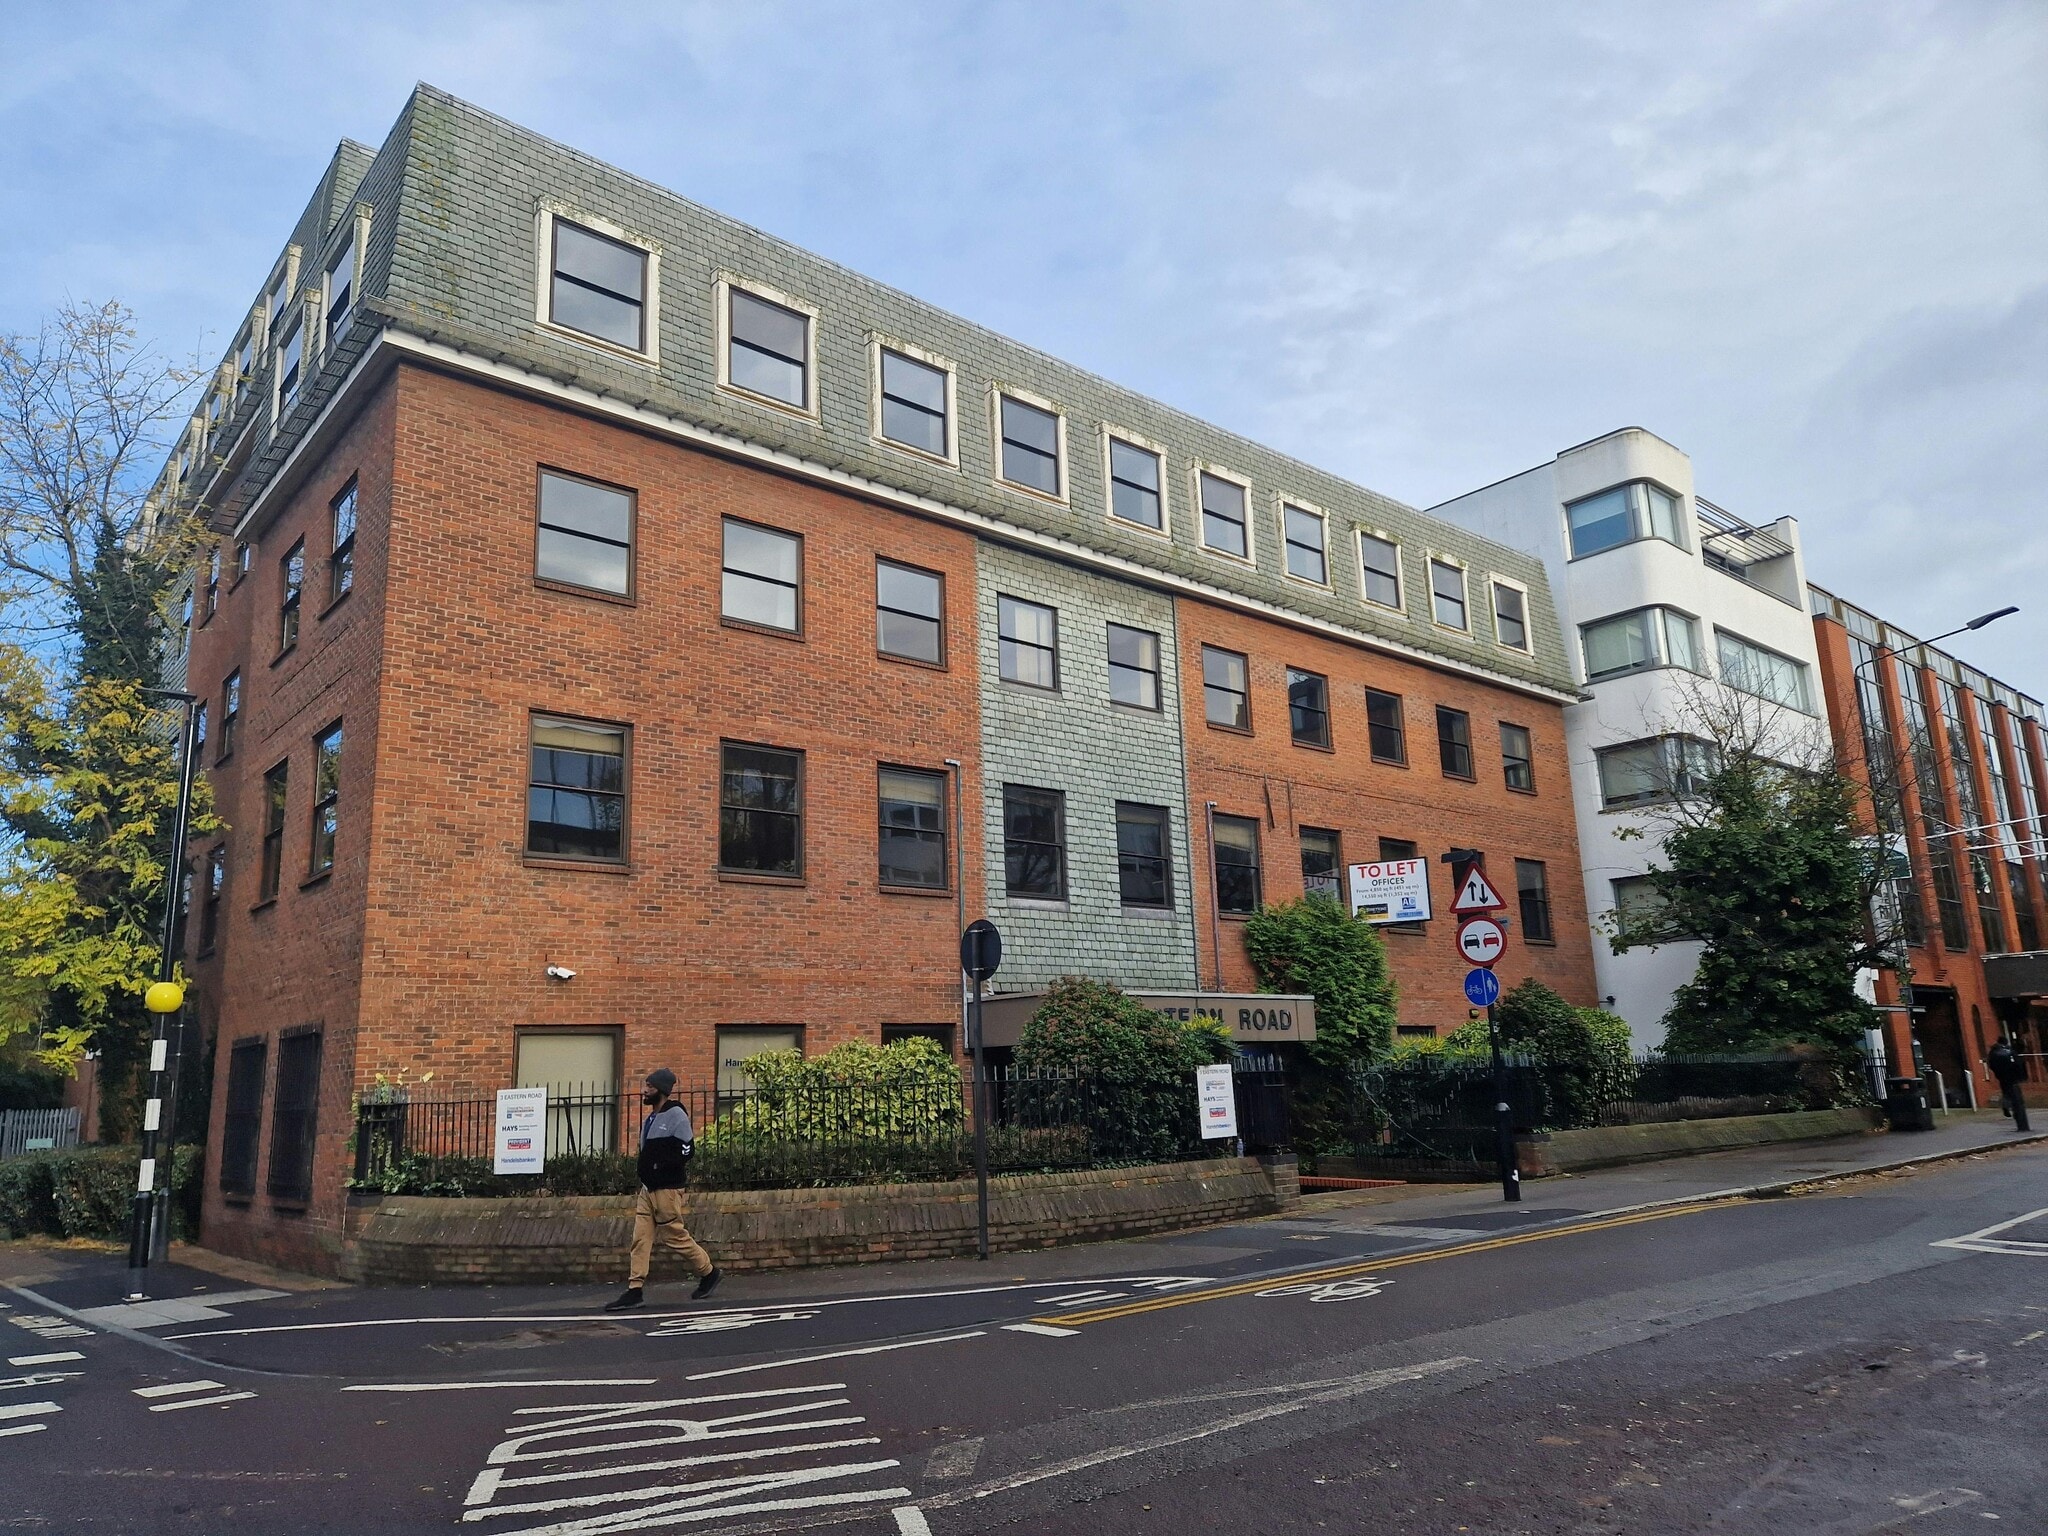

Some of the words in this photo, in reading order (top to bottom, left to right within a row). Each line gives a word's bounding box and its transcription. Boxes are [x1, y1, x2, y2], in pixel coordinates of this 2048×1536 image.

[1357, 865, 1381, 878] TO
[1387, 861, 1417, 876] LET
[1372, 877, 1405, 886] OFFICES
[1159, 1007, 1224, 1021] TERN
[1239, 1008, 1292, 1031] ROAD
